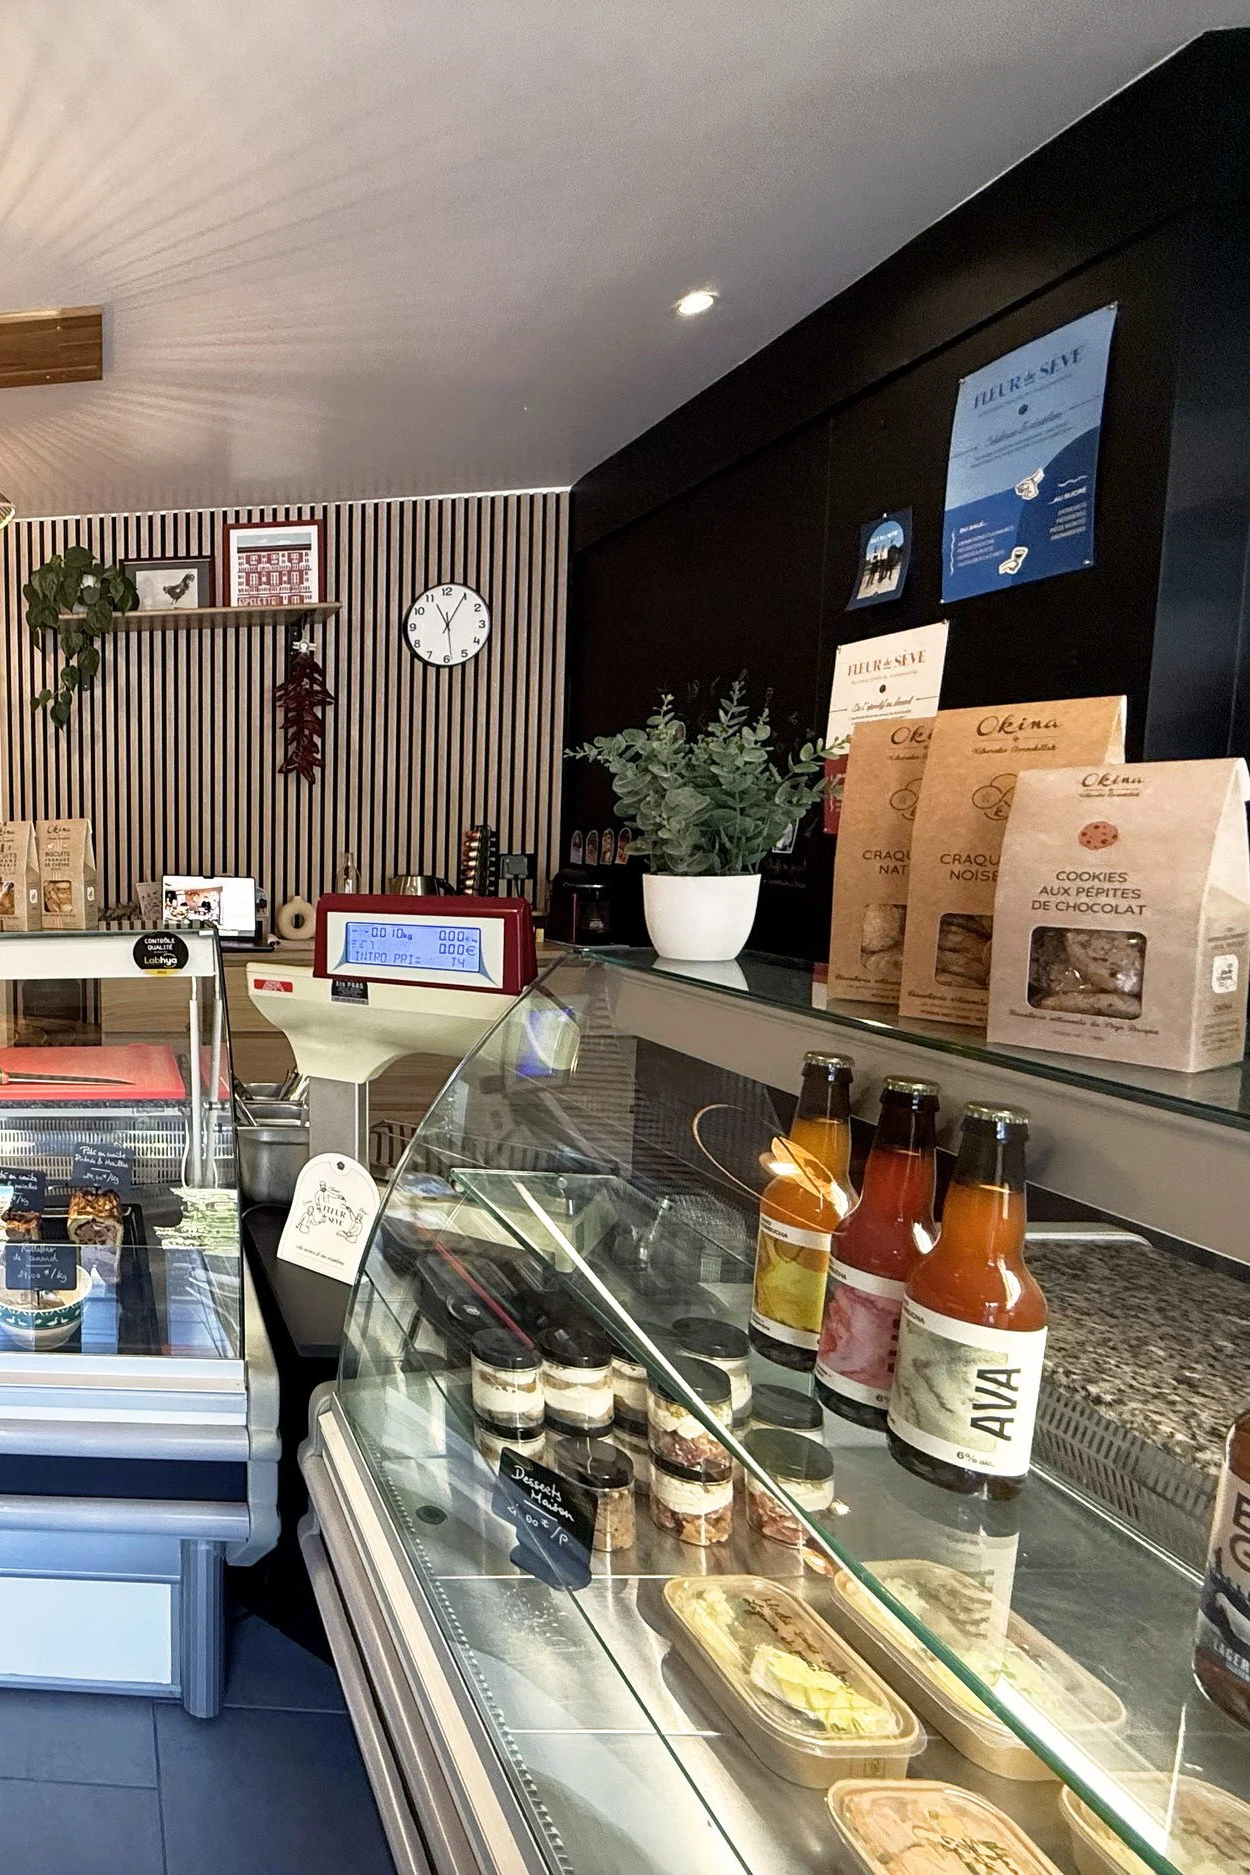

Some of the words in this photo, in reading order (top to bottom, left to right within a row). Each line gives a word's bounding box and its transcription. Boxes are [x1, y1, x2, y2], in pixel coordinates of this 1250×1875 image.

[442, 587, 453, 596] 12
[426, 594, 434, 602] 11
[414, 606, 425, 615] 10
[474, 604, 482, 612] 2
[409, 622, 417, 631] 9
[478, 620, 486, 628] 3
[414, 639, 421, 648] 8
[473, 637, 480, 645] 4
[427, 651, 433, 659] 7
[461, 649, 468, 658] 5
[444, 655, 450, 663] 6
[847, 659, 881, 677] FLEUR
[883, 656, 892, 669] de
[894, 649, 927, 668] SÈVE
[976, 715, 1061, 737] Okina
[1081, 772, 1144, 787] Okina
[1056, 871, 1129, 883] COOKIES
[1039, 886, 1071, 896] AUX
[1075, 885, 1142, 900] PÉPITES
[1031, 900, 1051, 911] DE
[1055, 901, 1147, 915] CHOCOLAT
[144, 956, 178, 966] Labhya
[970, 1367, 1023, 1442] AVA
[956, 1451, 979, 1464] 6%
[511, 1464, 563, 1502] Desserts
[529, 1489, 575, 1523] Maison
